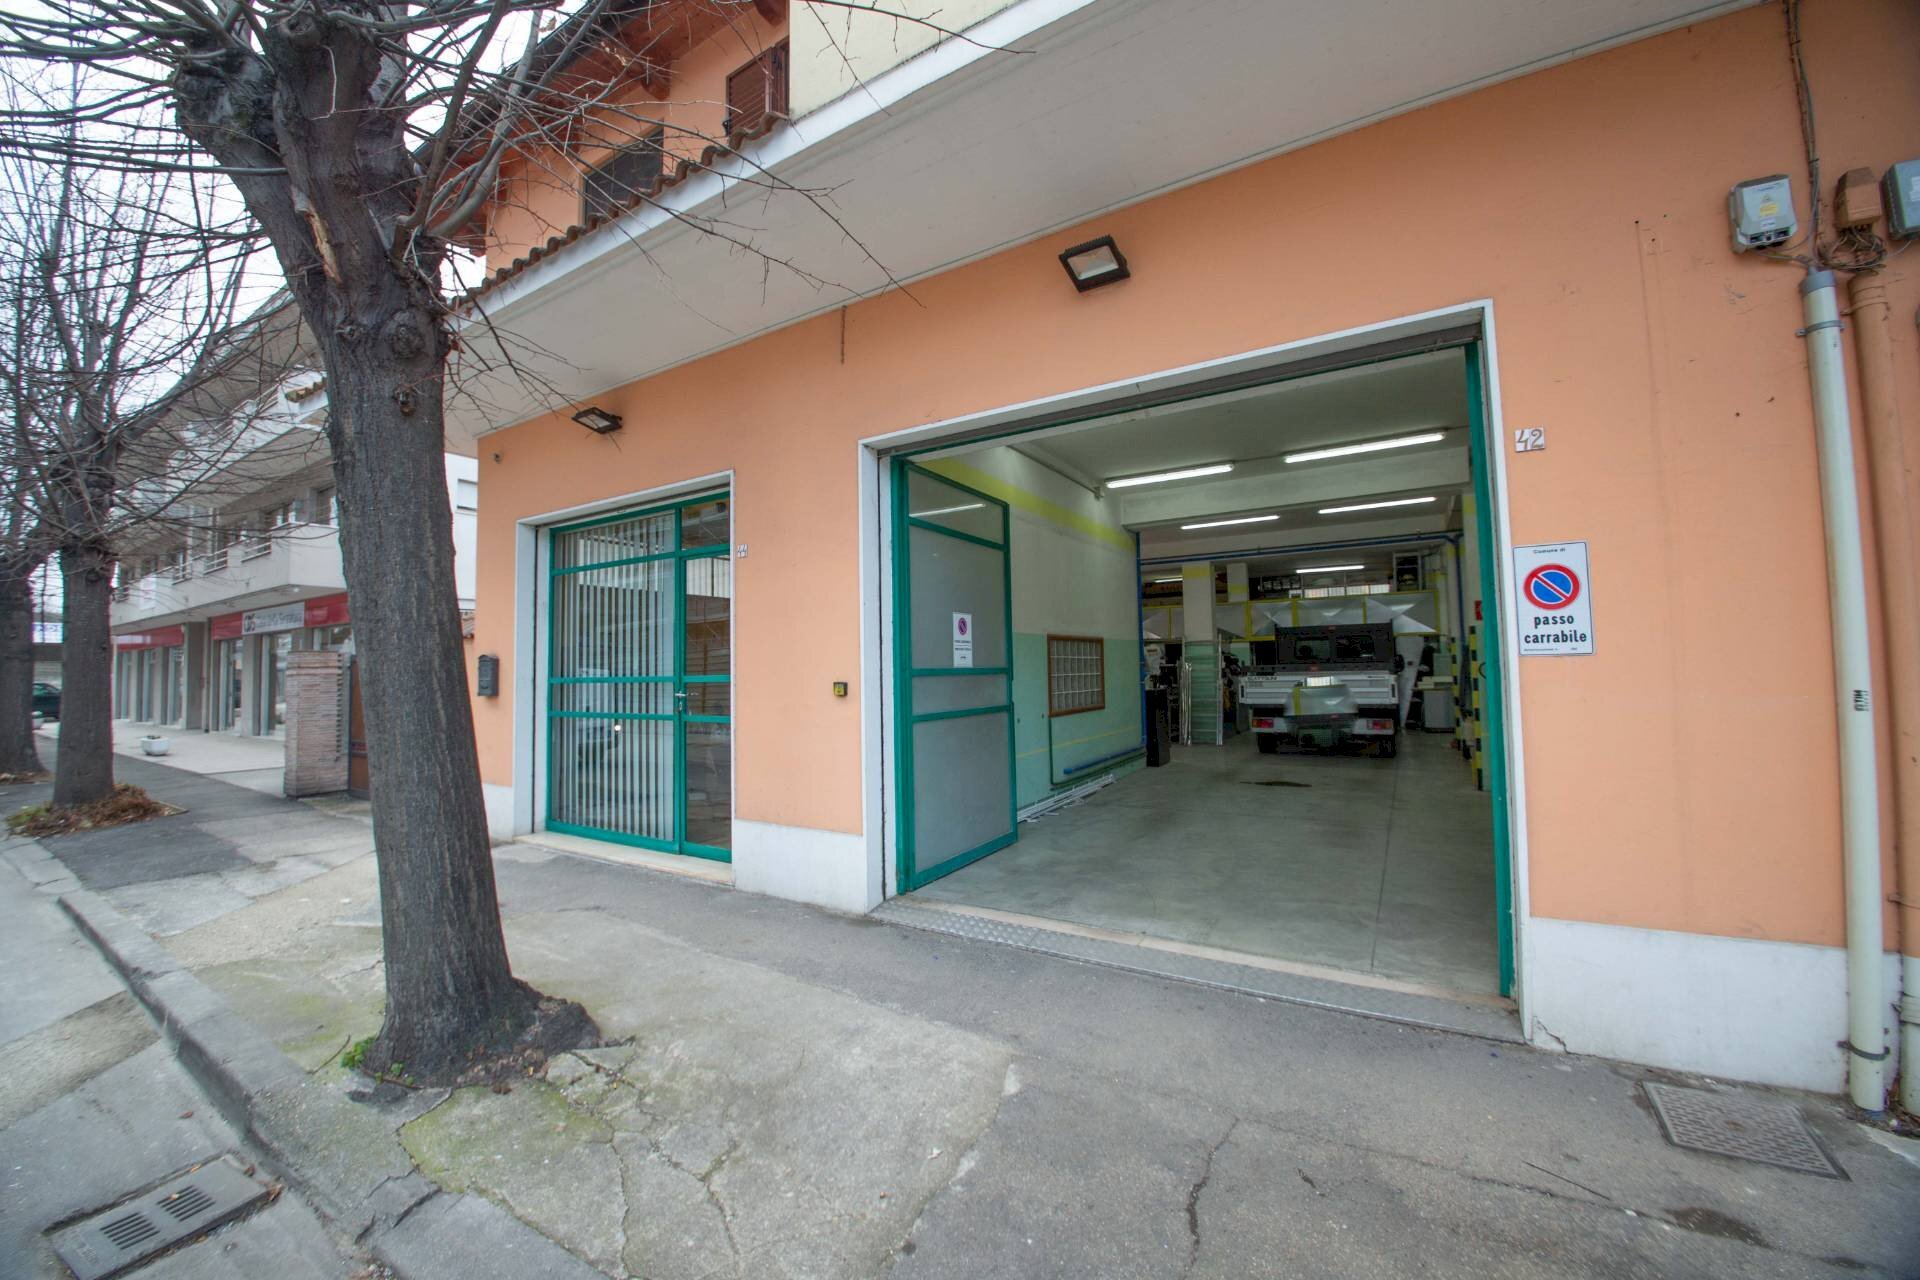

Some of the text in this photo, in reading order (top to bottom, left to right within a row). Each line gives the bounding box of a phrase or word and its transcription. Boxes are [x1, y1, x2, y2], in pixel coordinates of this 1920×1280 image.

[1517, 429, 1544, 450] 42
[1534, 615, 1574, 629] passo
[1524, 630, 1587, 644] carrabile
